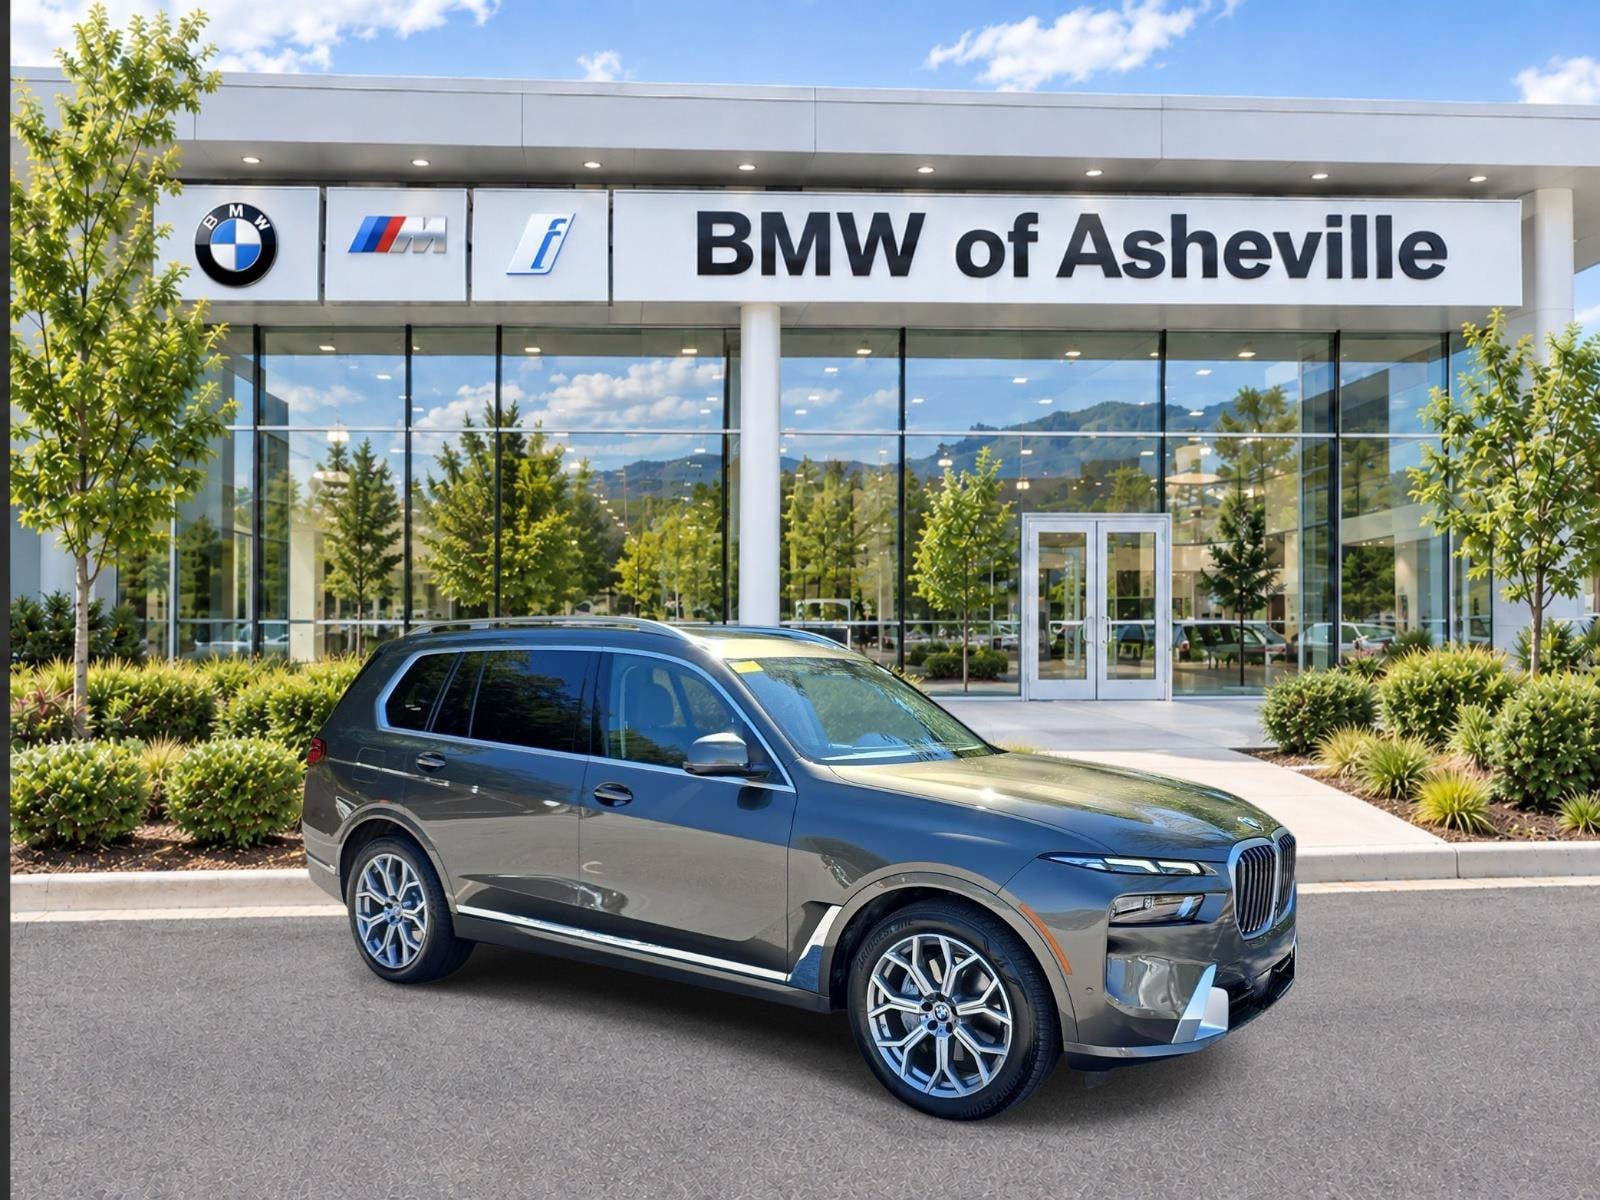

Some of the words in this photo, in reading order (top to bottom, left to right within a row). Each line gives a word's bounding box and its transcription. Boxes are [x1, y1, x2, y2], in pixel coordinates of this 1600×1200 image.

[203, 204, 270, 230] BMW
[389, 215, 447, 253] M
[696, 211, 925, 276] BMW
[955, 213, 1038, 279] of
[1056, 213, 1449, 280] Asheville
